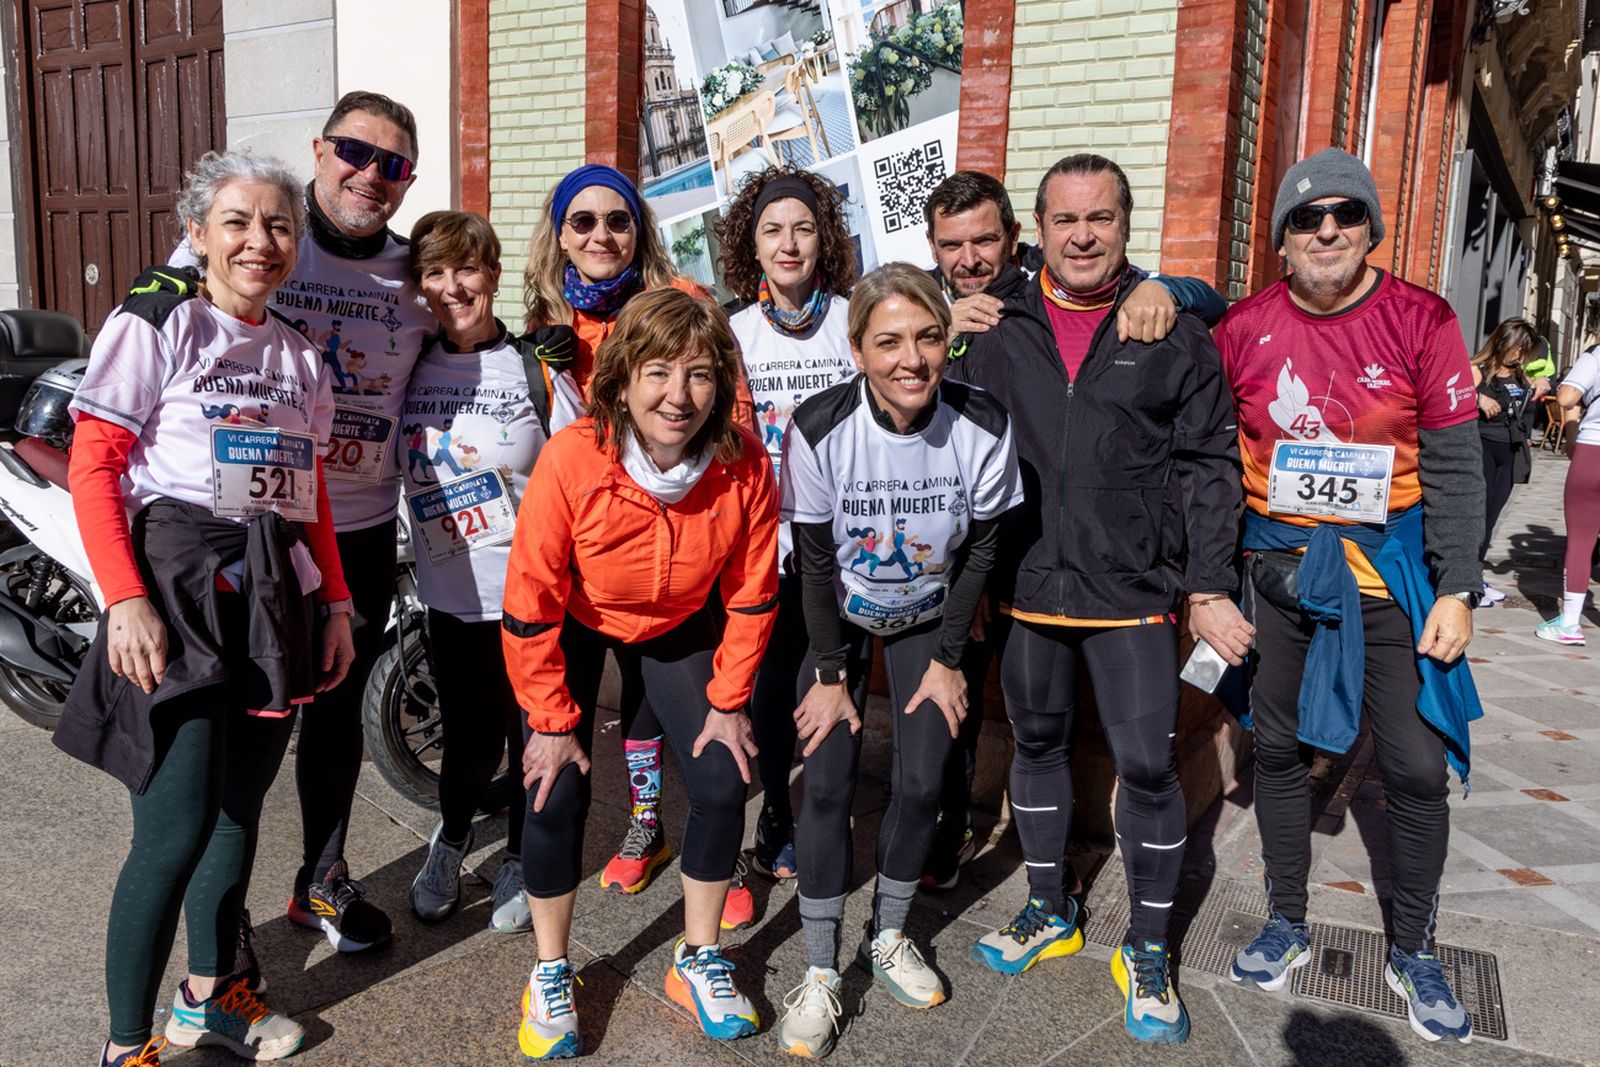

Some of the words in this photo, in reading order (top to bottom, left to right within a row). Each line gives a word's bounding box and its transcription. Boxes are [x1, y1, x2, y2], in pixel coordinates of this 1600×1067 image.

[290, 280, 345, 297] CARRERA
[348, 289, 399, 305] CAMINATA
[276, 291, 322, 312] BUENA
[326, 299, 379, 321] MUERTE
[197, 358, 210, 369] VI
[747, 364, 757, 373] VI
[759, 360, 802, 372] CARRERA
[805, 358, 852, 369] CAMINATA
[748, 376, 783, 392] BUENA
[787, 373, 833, 390] MUERTE
[193, 375, 244, 395] BUENA
[248, 380, 298, 408] MUERTE
[417, 386, 459, 396] CARRERA
[463, 387, 520, 400] CAMINATA
[404, 401, 436, 415] BUENA
[440, 401, 492, 415] MUERTE
[342, 413, 380, 426] CAMINATA
[1290, 414, 1321, 440] 43
[332, 423, 360, 437] UERTE
[228, 434, 236, 443] VI
[238, 435, 278, 445] CARRERA
[228, 446, 262, 460] BUENA
[265, 448, 294, 464] MUERTE
[1290, 447, 1297, 455] VI
[1298, 448, 1333, 458] CARRERA
[1335, 450, 1376, 460] CAMINATA
[1287, 457, 1316, 470] BUENA
[1318, 459, 1356, 474] MUERTE
[249, 466, 295, 500] 521
[453, 476, 488, 493] CAMINATA
[843, 482, 854, 493] VI
[856, 480, 909, 492] CARRERA
[912, 475, 961, 491] CAMINA
[1296, 473, 1358, 504] 345
[423, 502, 447, 518] BUENA
[447, 491, 479, 510] MUERTE
[842, 498, 886, 516] BUENA
[891, 494, 946, 515] MUERTE
[441, 506, 489, 540] 921
[861, 600, 869, 608] VI
[858, 608, 887, 618] BUENA
[888, 608, 921, 618] MUERTE
